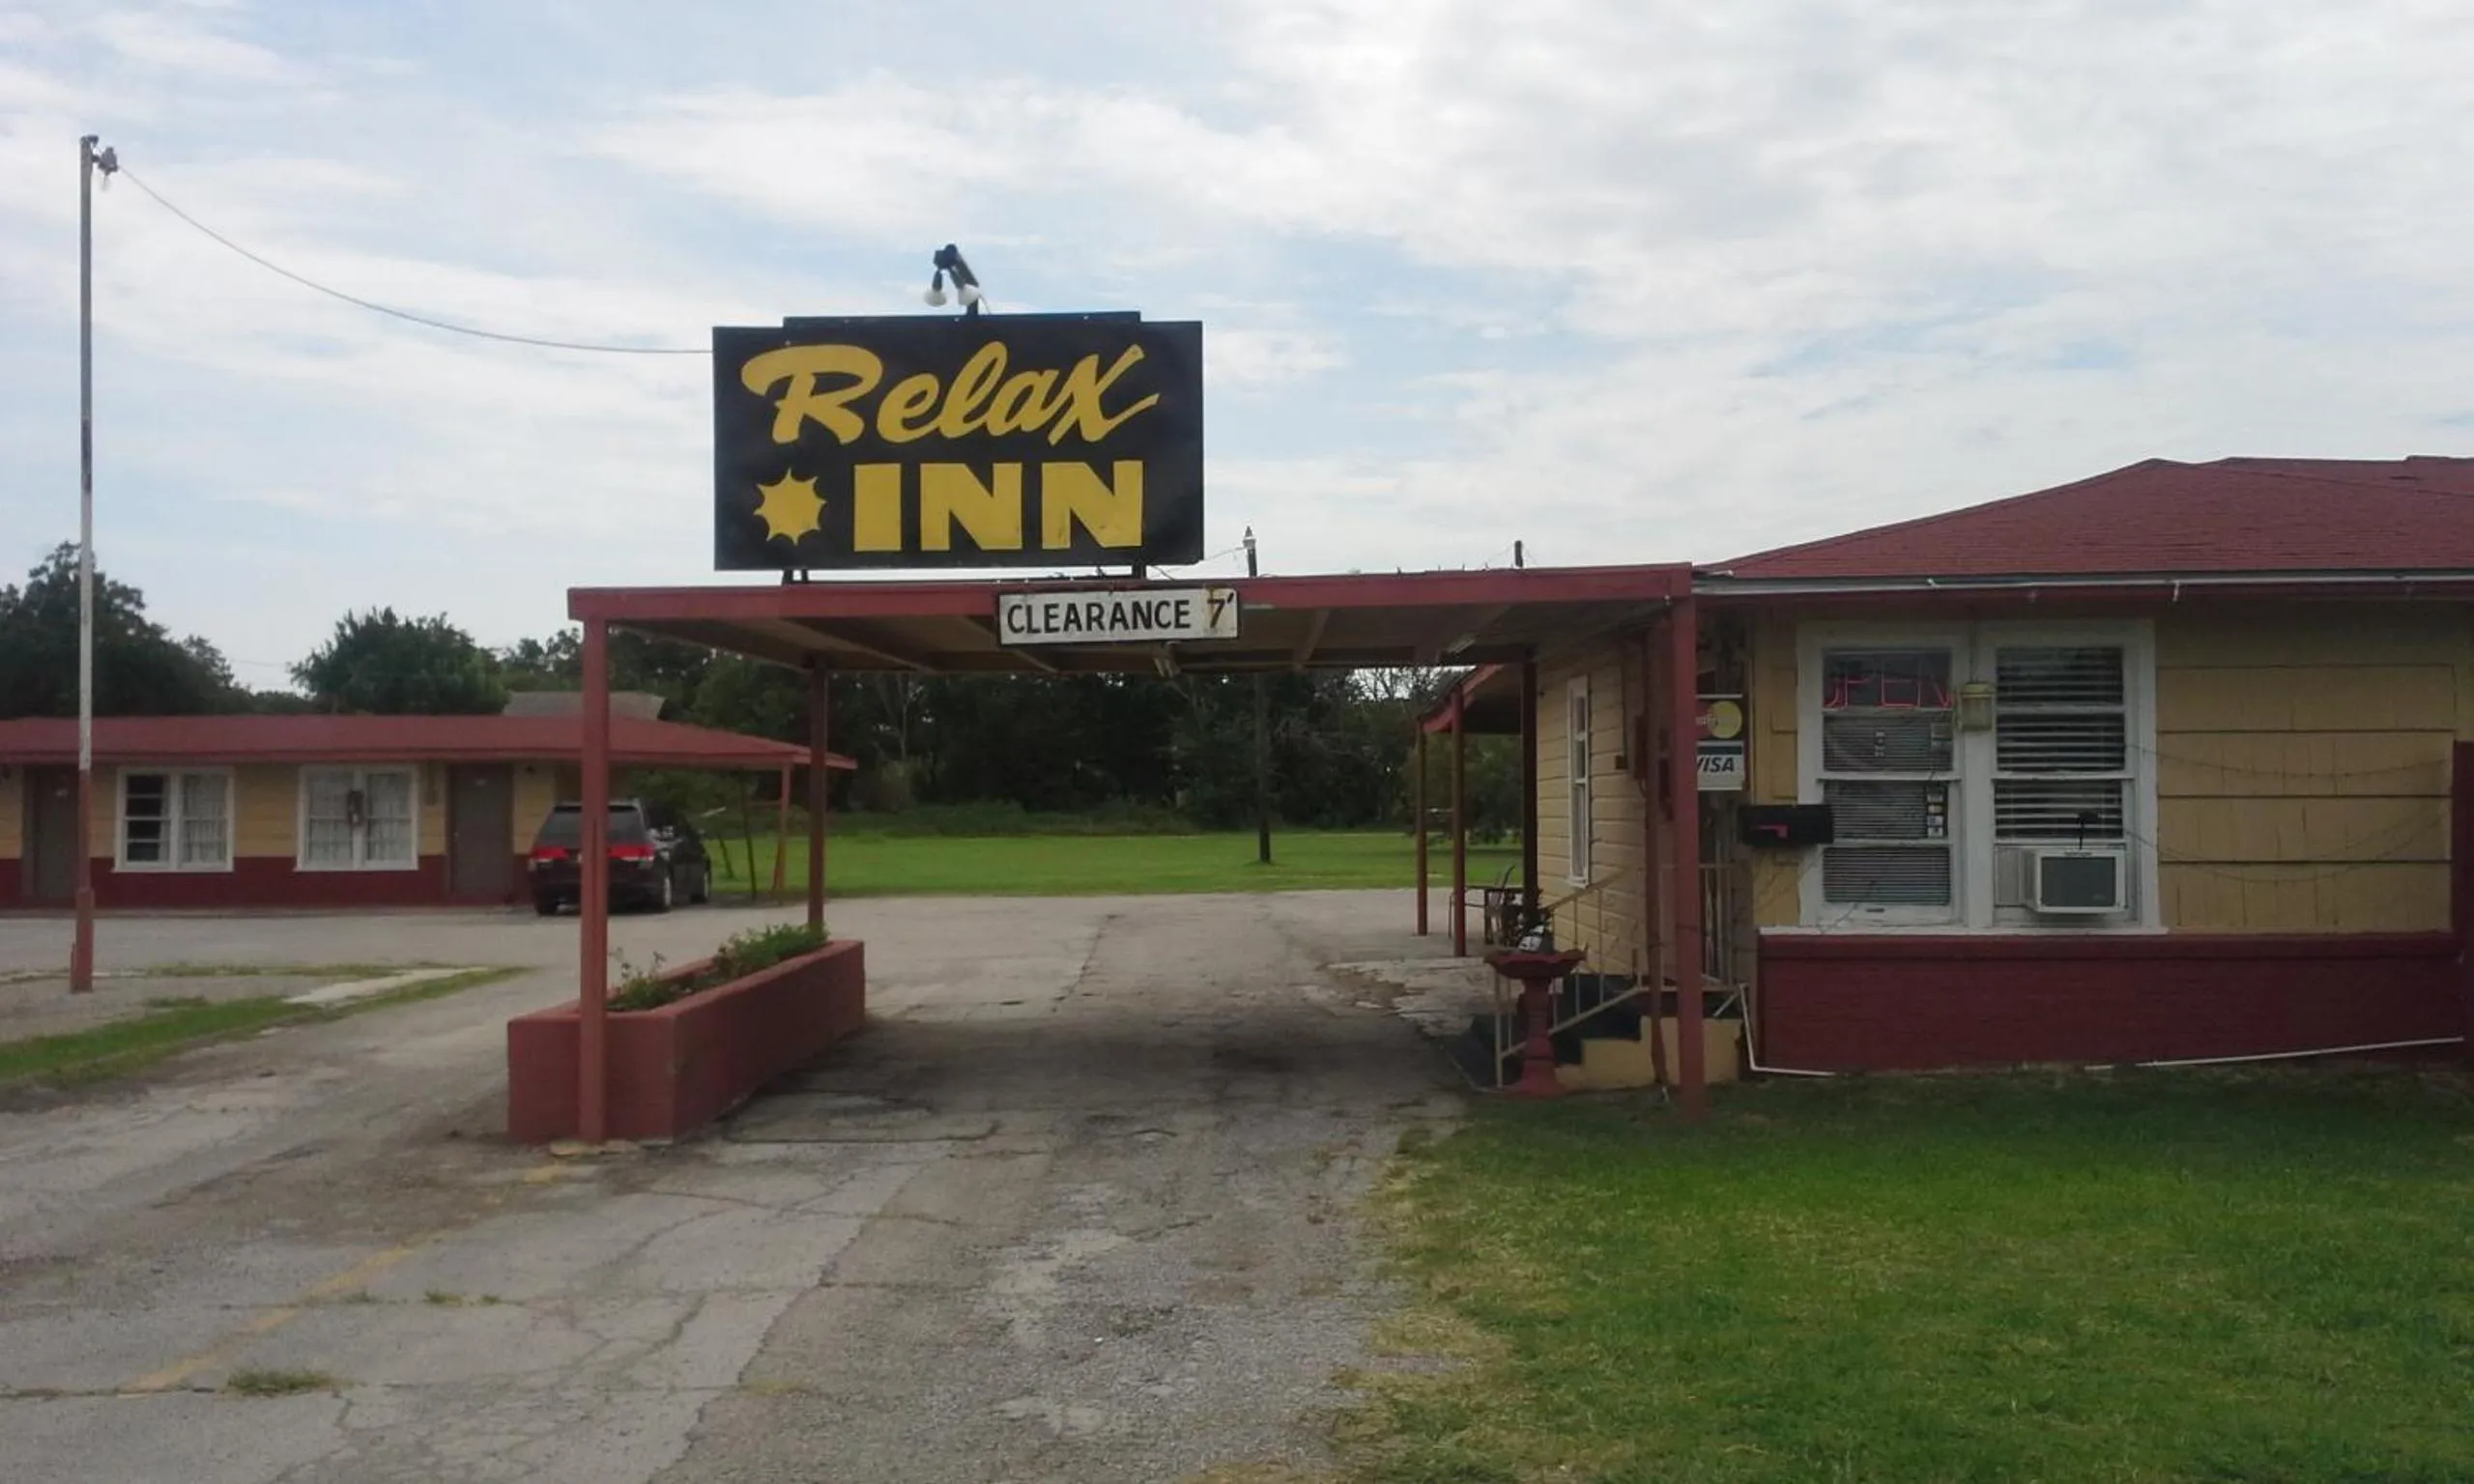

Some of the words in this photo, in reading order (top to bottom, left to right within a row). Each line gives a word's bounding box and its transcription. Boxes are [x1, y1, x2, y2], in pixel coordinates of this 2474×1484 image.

[741, 341, 1159, 445] Relax
[854, 460, 1143, 552] INN
[1007, 599, 1192, 634] CLEARANCE
